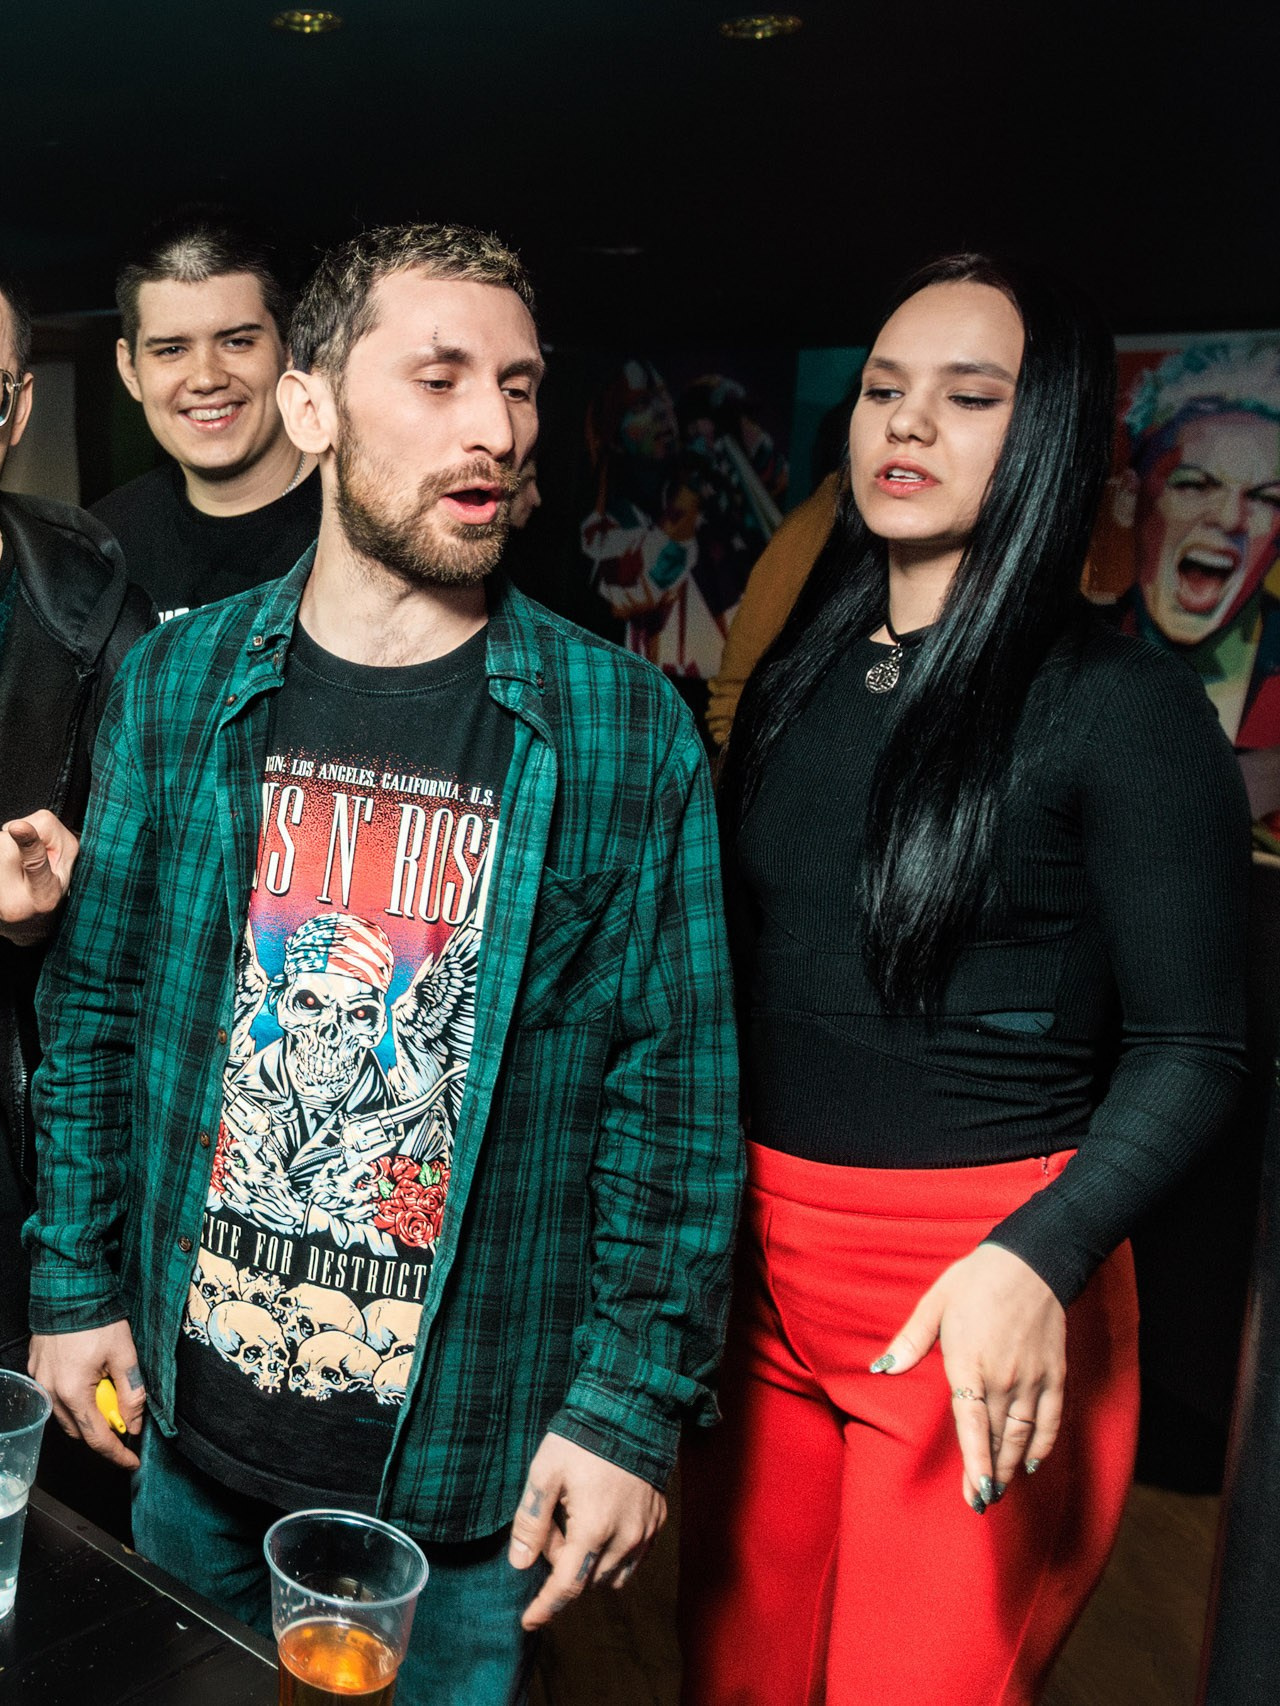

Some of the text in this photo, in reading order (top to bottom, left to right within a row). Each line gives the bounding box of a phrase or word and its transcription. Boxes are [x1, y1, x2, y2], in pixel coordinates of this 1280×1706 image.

[291, 759, 314, 778] LOS
[253, 1231, 294, 1276] FOR
[306, 1245, 434, 1300] DESTRUCT
